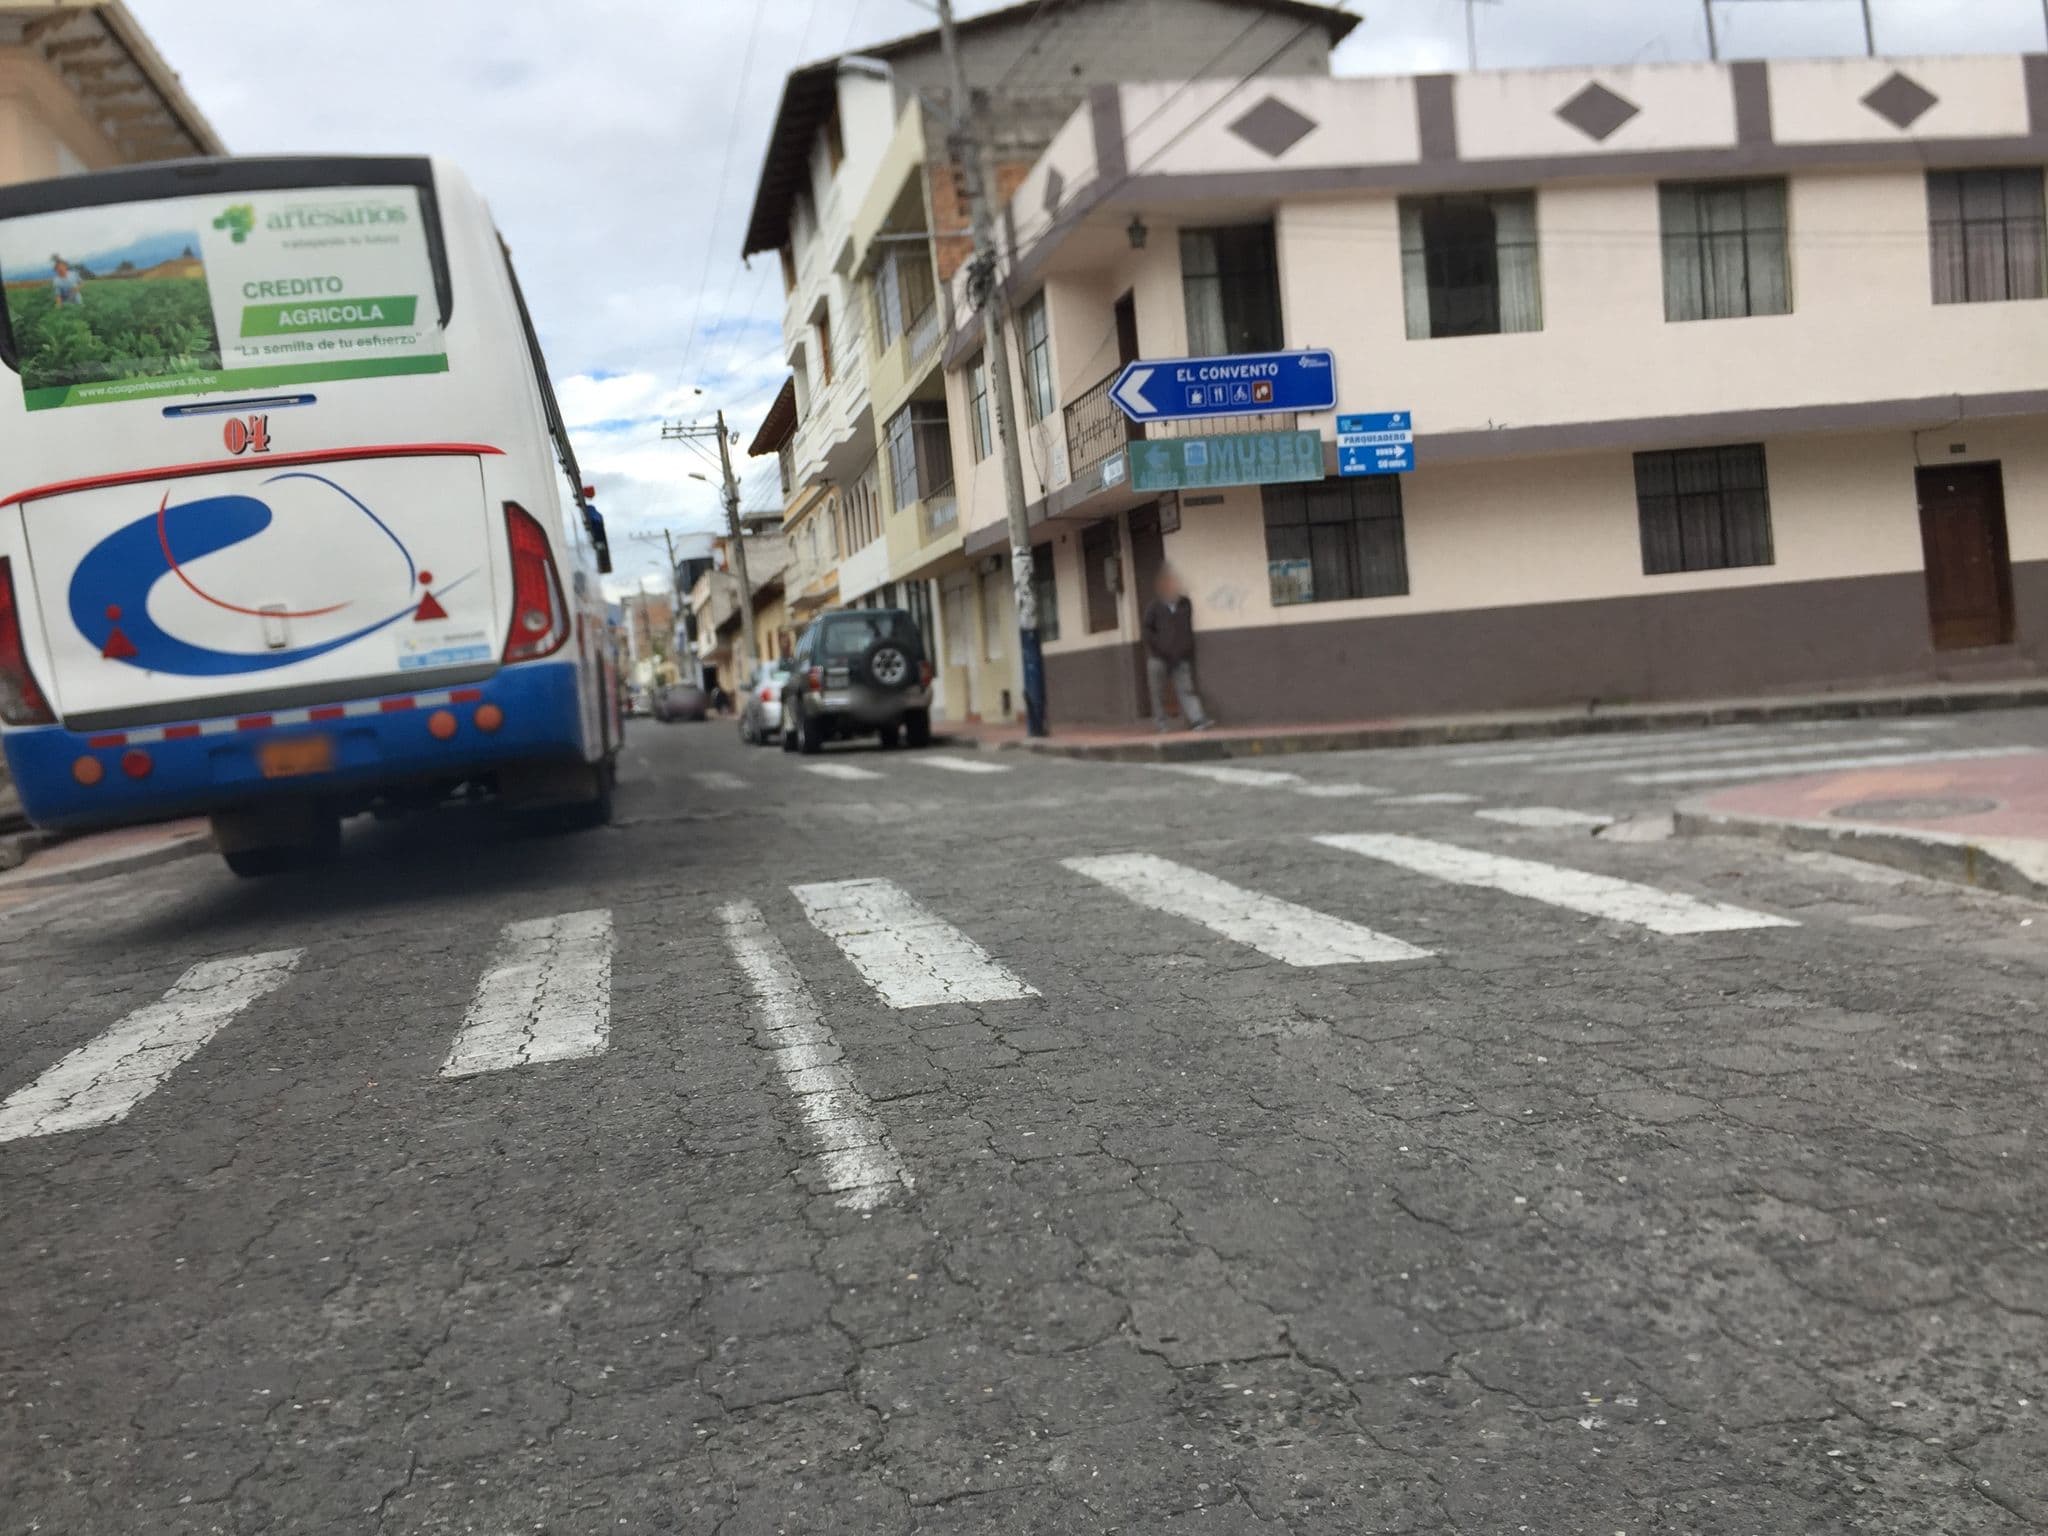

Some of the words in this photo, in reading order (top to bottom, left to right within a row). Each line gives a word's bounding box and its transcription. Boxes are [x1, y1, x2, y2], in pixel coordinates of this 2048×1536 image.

[243, 276, 344, 298] CREDITO
[278, 304, 384, 327] AGRICOLA
[263, 339, 314, 354] semilla
[318, 337, 335, 350] de
[339, 337, 353, 348] tu
[1176, 367, 1196, 382] EL
[1199, 362, 1279, 381] CONVENTO
[223, 413, 271, 455] 04
[1343, 432, 1406, 444] PARQUEADERO
[1209, 433, 1315, 465] MUSEO
